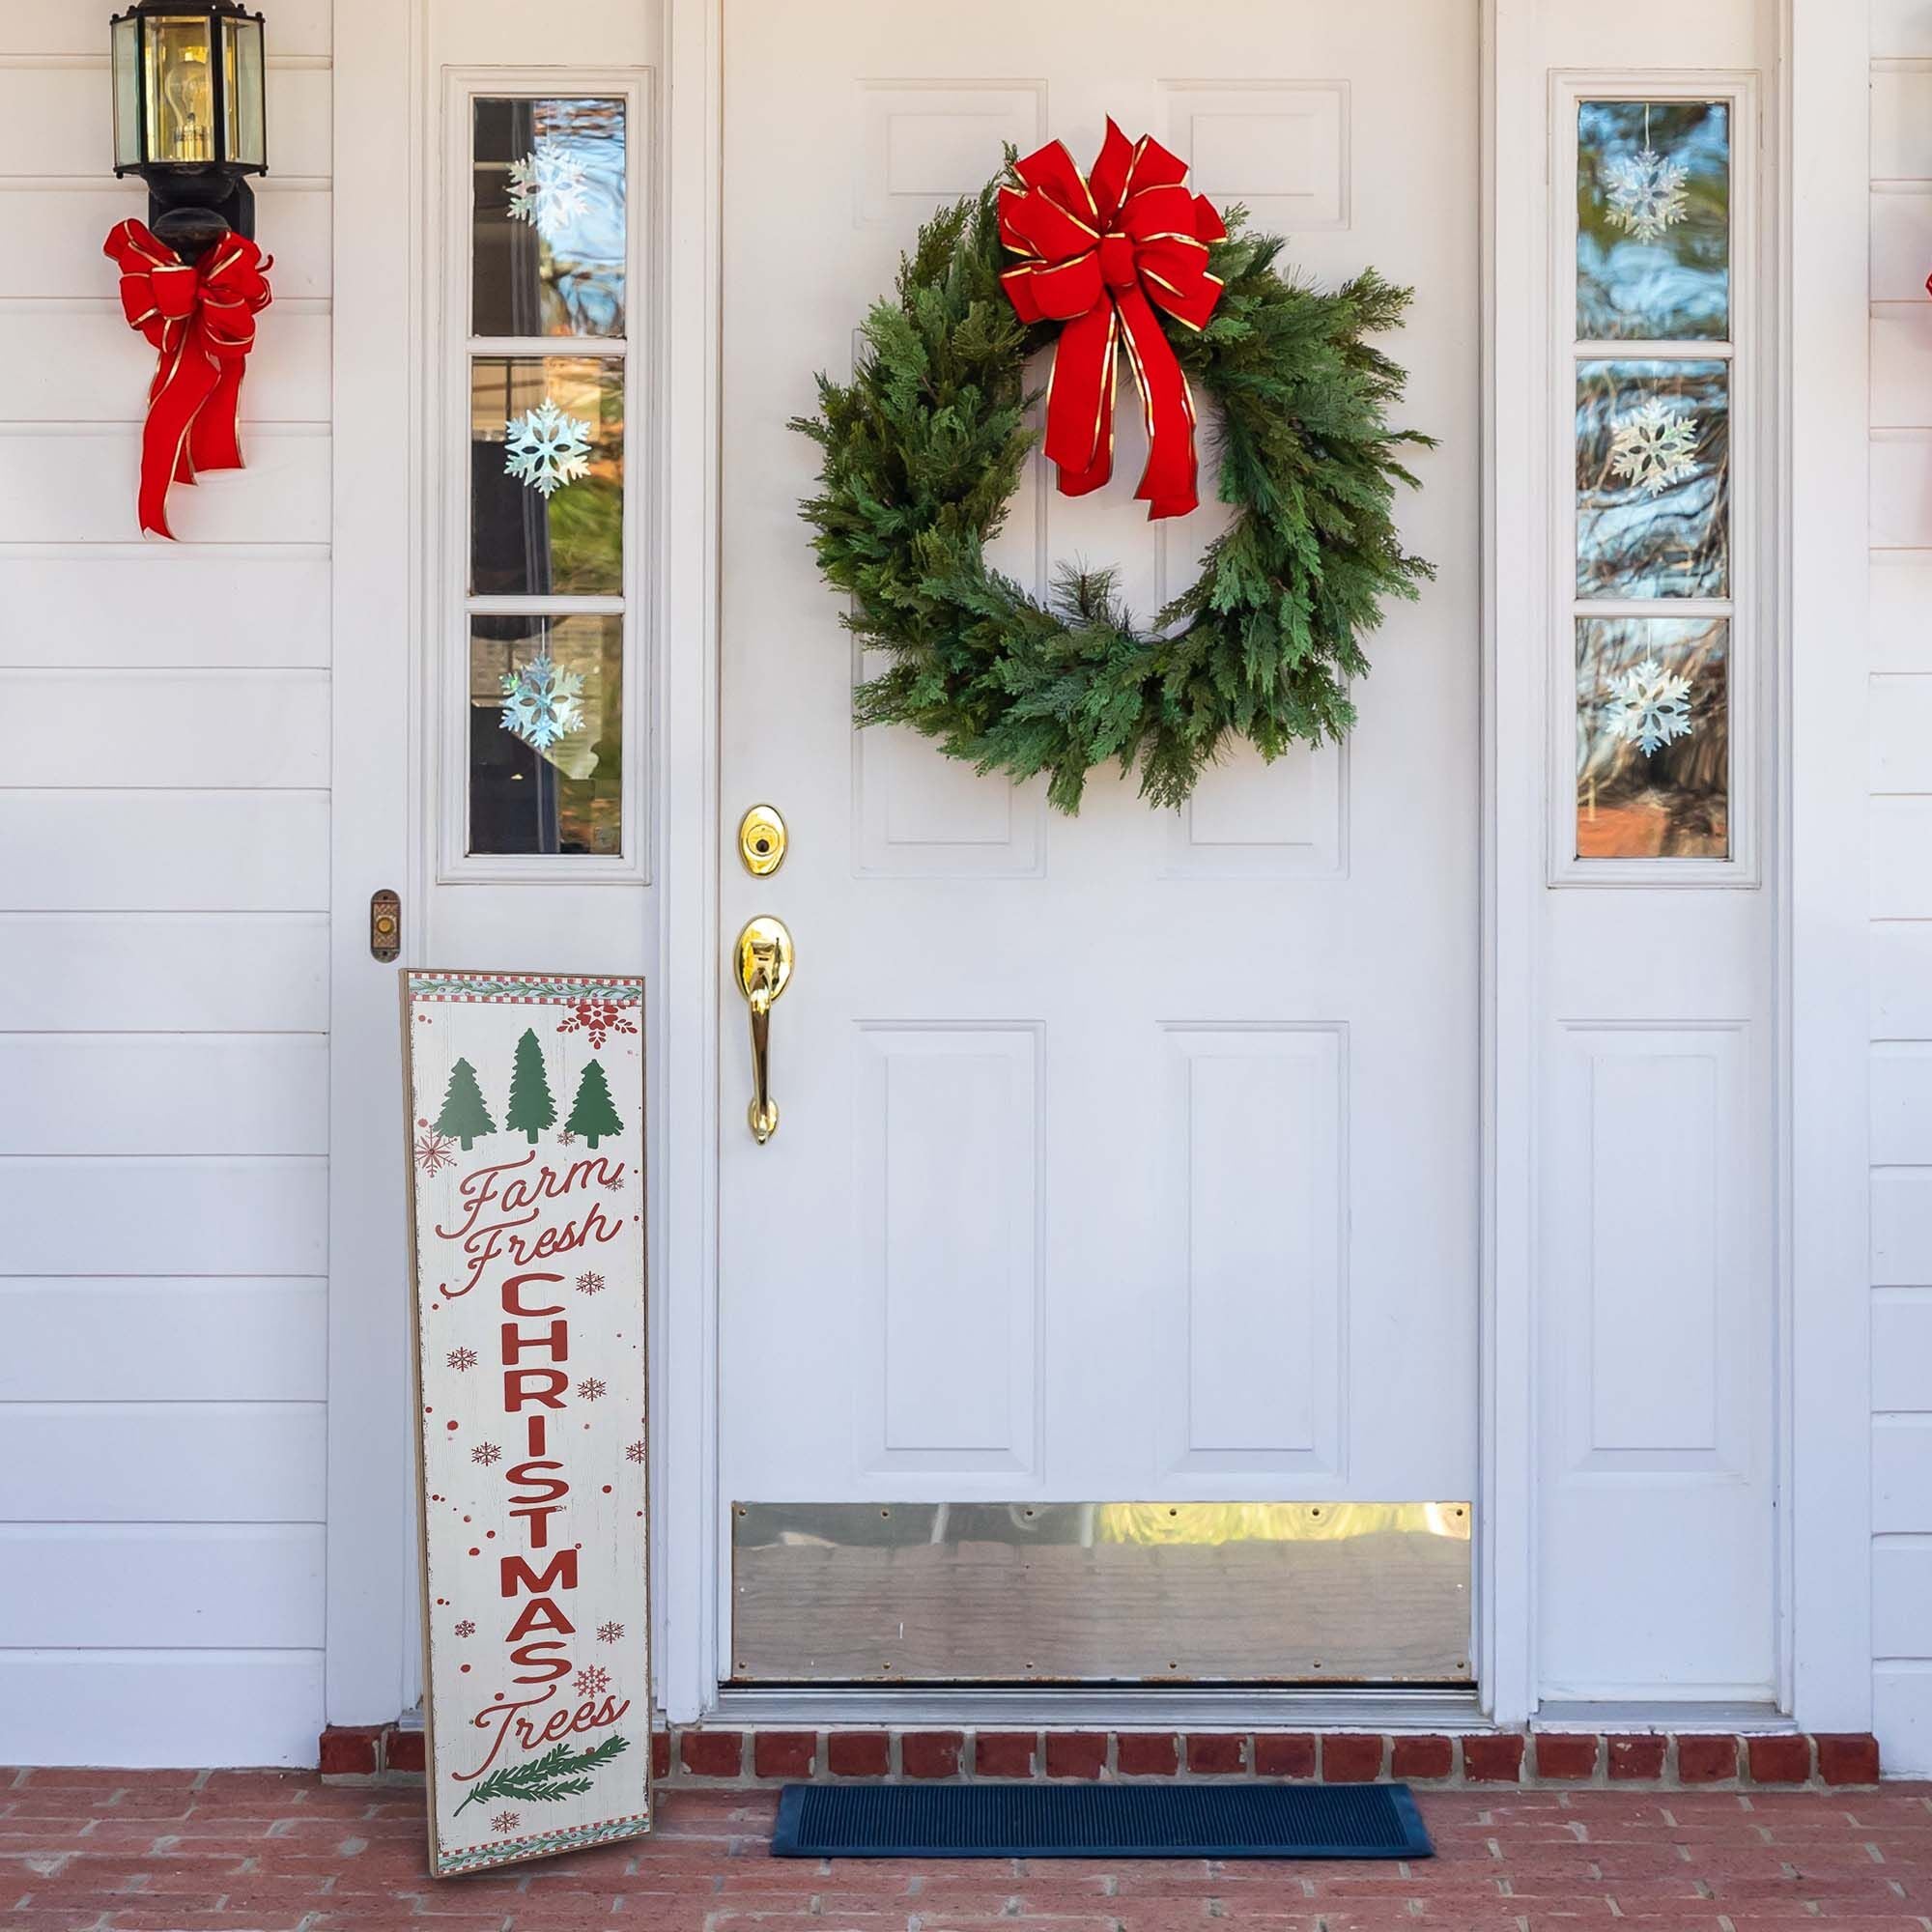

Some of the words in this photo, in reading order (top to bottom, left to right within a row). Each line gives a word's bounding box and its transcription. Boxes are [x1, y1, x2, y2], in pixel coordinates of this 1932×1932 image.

[436, 1150, 625, 1239] Farm
[440, 1203, 623, 1297] Fresh
[500, 1272, 579, 1684] CHRISTMAS
[451, 1685, 630, 1781] Trees
